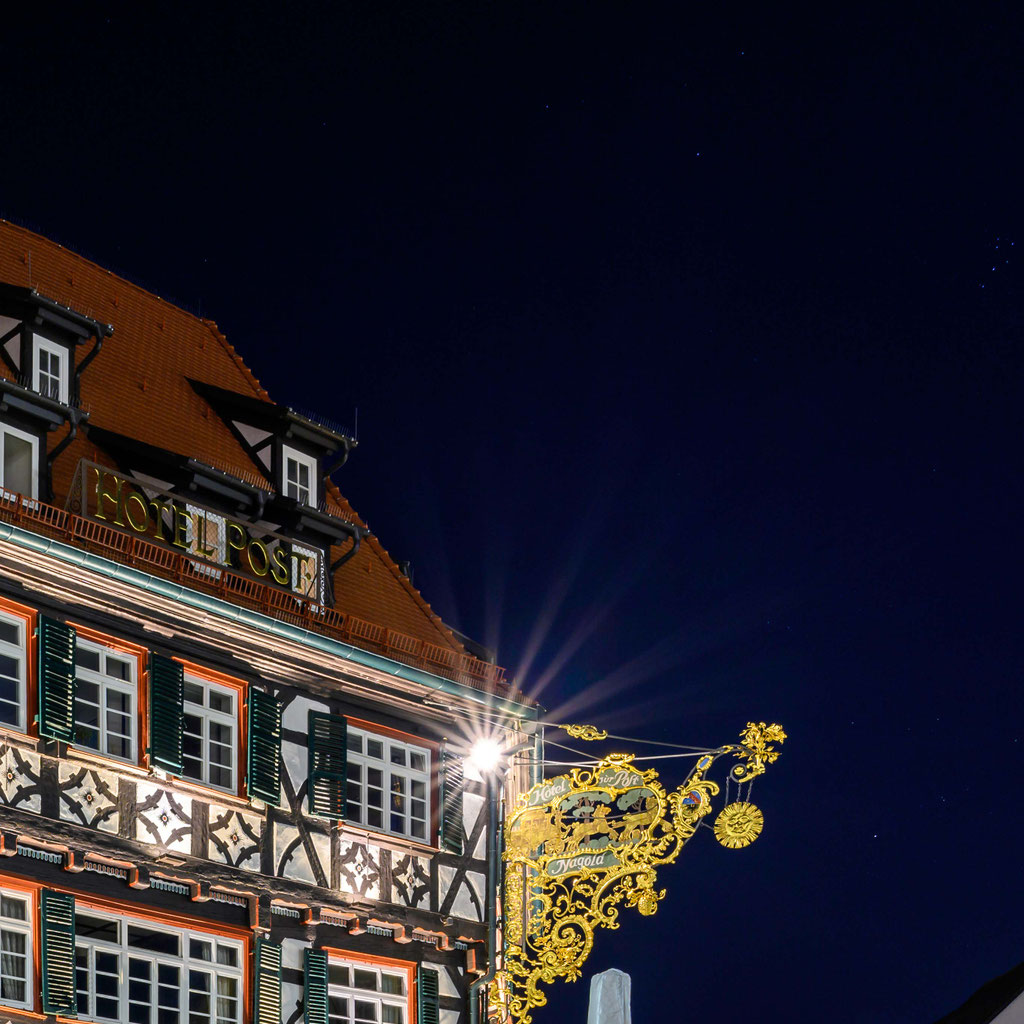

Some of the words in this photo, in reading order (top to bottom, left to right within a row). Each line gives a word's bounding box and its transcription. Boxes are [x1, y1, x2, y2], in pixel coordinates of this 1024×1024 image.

[94, 468, 217, 556] HOTEL
[225, 519, 312, 590] POST
[529, 782, 566, 806] Hotel
[608, 770, 640, 788] Post
[551, 852, 605, 876] Nagold
